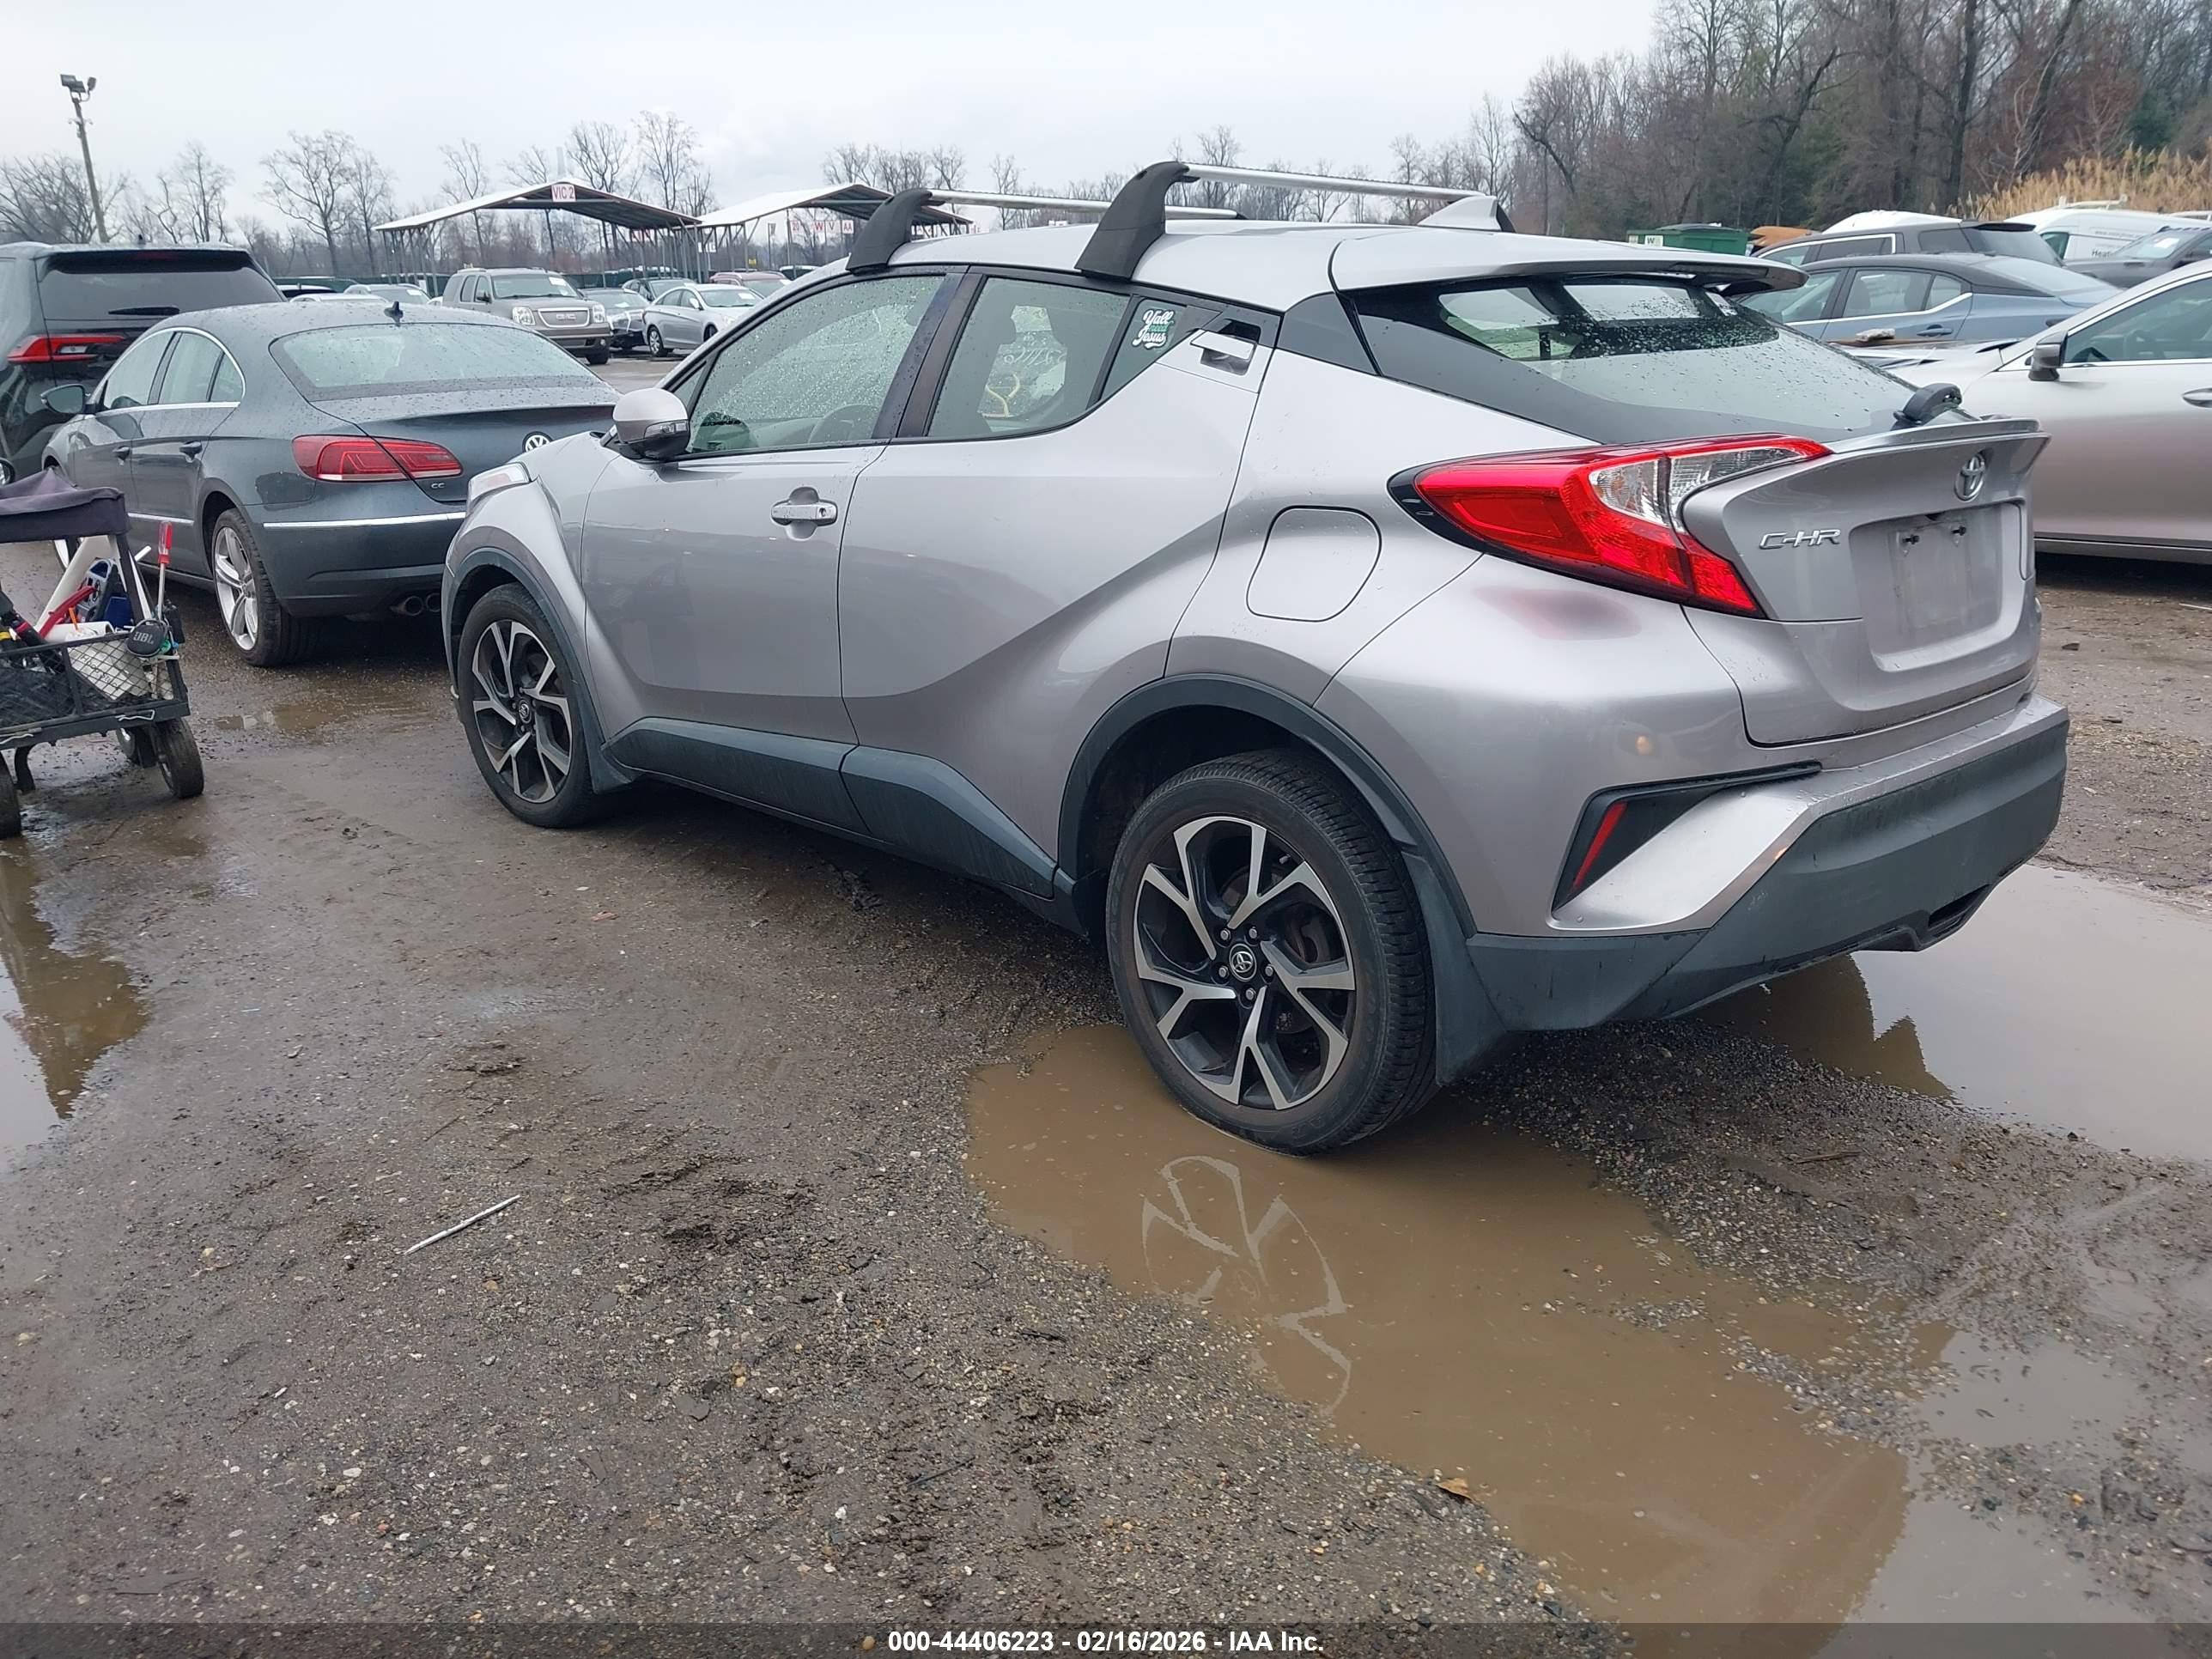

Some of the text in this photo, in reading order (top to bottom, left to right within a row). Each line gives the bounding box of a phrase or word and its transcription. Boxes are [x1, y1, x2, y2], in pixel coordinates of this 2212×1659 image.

[552, 186, 574, 199] VIC 2
[814, 222, 823, 231] W
[829, 222, 836, 230] V
[843, 222, 852, 231] AA
[1133, 325, 1167, 349] Jesus
[1759, 529, 1841, 550] C-HR
[133, 631, 155, 645] JBL
